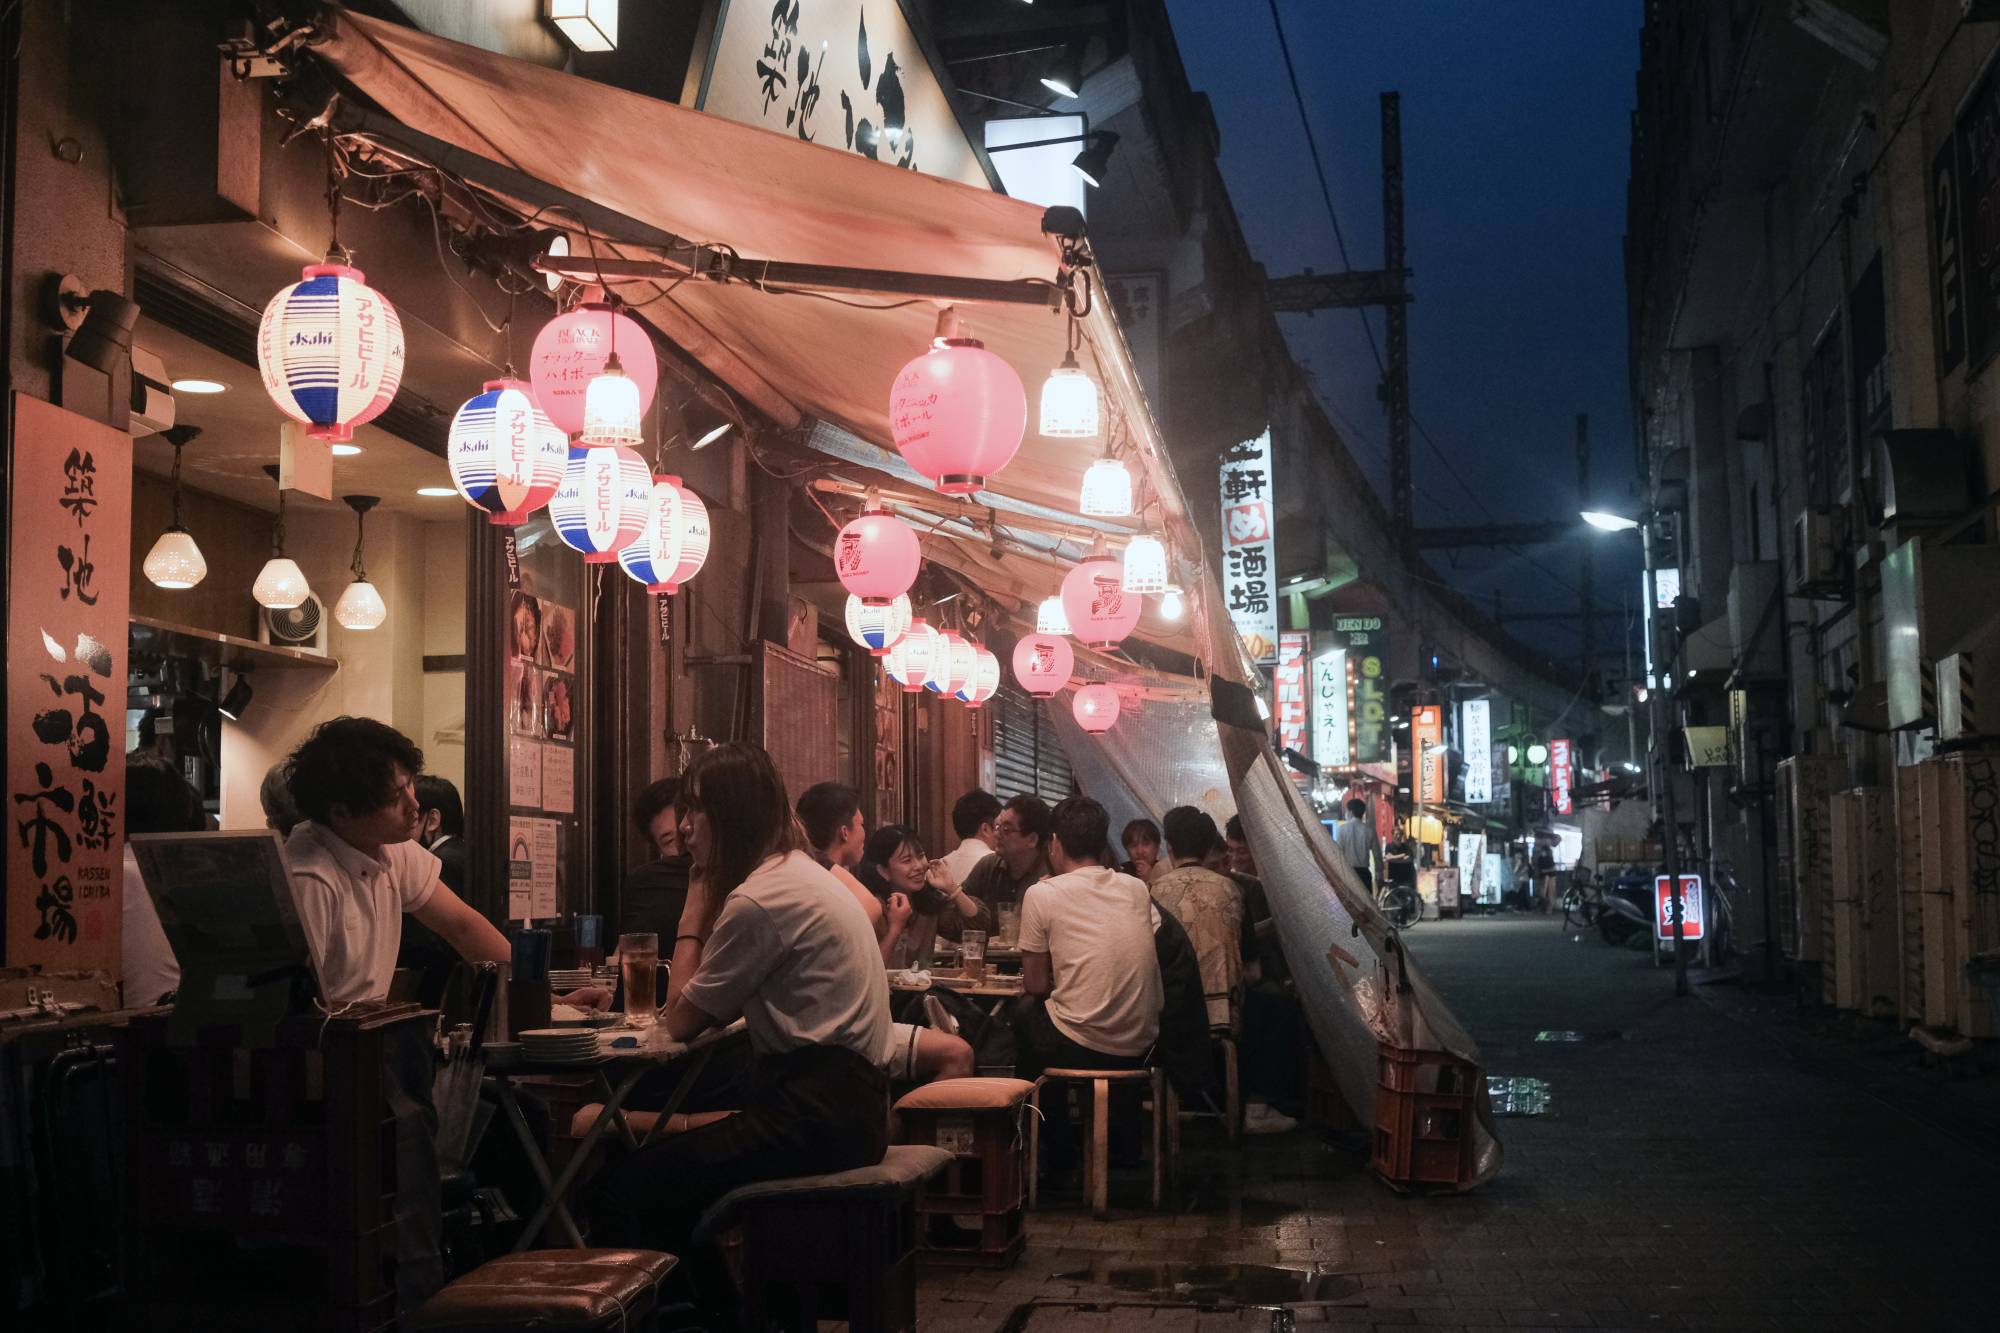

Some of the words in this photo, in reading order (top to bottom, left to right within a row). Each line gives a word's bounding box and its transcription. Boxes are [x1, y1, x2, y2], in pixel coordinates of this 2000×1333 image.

[290, 331, 333, 346] Asahi
[350, 297, 375, 390] アサヒビール
[459, 439, 489, 453] Asahi
[508, 409, 526, 486] アサヒビール
[540, 441, 565, 456] Asahi
[595, 463, 611, 532] アサヒビール
[625, 487, 648, 500] Asahi
[657, 497, 672, 559] アサヒビール
[505, 536, 519, 583] アサヒビール
[1362, 656, 1383, 745] SLOT
[78, 867, 111, 880] KASSEN
[78, 885, 111, 898] ICHIBA
